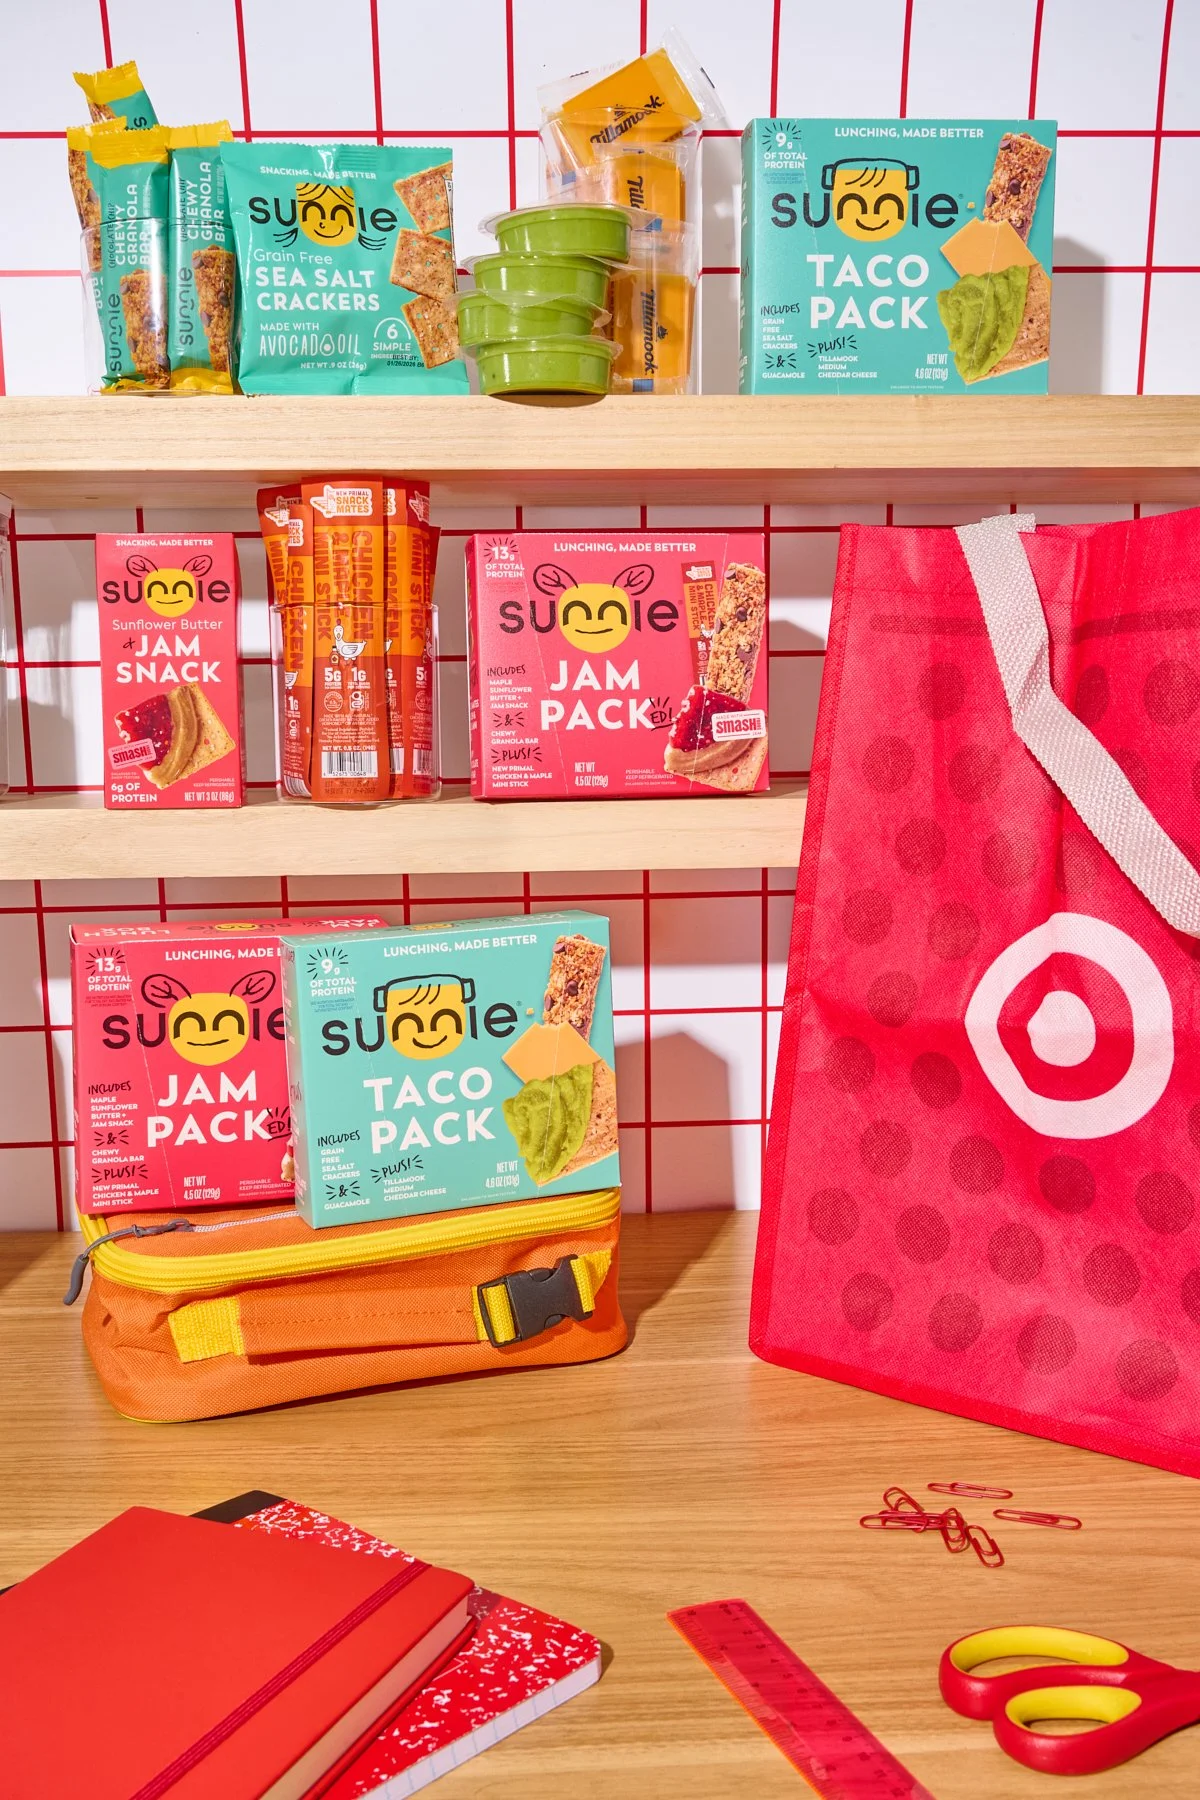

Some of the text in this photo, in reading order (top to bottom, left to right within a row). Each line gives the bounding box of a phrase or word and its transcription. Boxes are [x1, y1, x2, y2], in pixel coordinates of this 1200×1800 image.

[835, 128, 983, 138] LUNCHING, MADE BETTER
[764, 152, 808, 160] OF TOTAL
[342, 171, 376, 180] BETTER
[200, 162, 212, 240] GRANOLA
[186, 181, 198, 240] CHEWY
[249, 197, 398, 232] sunnie
[771, 193, 958, 228] sunnie
[127, 184, 138, 265] GRANOLA
[215, 210, 225, 241] BAR
[115, 204, 125, 265] CHEWY
[139, 232, 151, 265] BAR
[254, 249, 332, 264] Grain Free
[256, 267, 374, 288] SEA SALT
[807, 254, 929, 288] TACO
[178, 267, 194, 345] sunnie
[257, 292, 380, 311] CRACKERS
[761, 303, 800, 316] INCLUDES
[810, 297, 928, 329] PACK
[109, 293, 122, 371] sunnie
[260, 323, 290, 331] MADE
[387, 324, 398, 338] 6
[641, 289, 659, 375] Tillamook
[338, 334, 361, 355] OIL
[373, 343, 411, 351] SIMPLE
[819, 337, 846, 352] PLUS!
[492, 546, 514, 560] 13g
[554, 543, 696, 553] LUNCHING, MADE BETTER
[103, 580, 230, 604] sunnie
[352, 531, 372, 640] CHICKEN
[499, 600, 679, 633] sunnie
[112, 619, 223, 631] Sunflower Butter
[135, 635, 200, 657] JAM
[116, 662, 221, 683] SNACK
[487, 665, 525, 676] INCLUDES
[550, 660, 640, 691] JAM
[503, 749, 530, 760] PLUS!
[112, 794, 157, 802] PROTEIN
[383, 934, 537, 958] LUNCHING, MADE BETTER
[166, 949, 235, 961] LUNCHING,
[238, 948, 274, 958] MADE
[95, 957, 120, 973] 13g
[102, 974, 132, 983] TOTAL
[310, 977, 356, 989] OF TOTAL
[89, 983, 130, 991] PROTEIN
[311, 986, 354, 997] PROTEIN
[321, 1002, 518, 1056] sunnie
[89, 1081, 131, 1094] INCLUDES
[158, 1070, 257, 1107] JAM
[363, 1066, 493, 1112] TACO
[91, 1103, 138, 1111] SUNFLOWER
[91, 1119, 133, 1128] JAM SNACK
[370, 1107, 496, 1154] PACK
[317, 1130, 360, 1147] INCLUDES
[92, 1149, 119, 1157] CHEWY
[321, 1147, 344, 1155] GRAIN
[92, 1156, 128, 1164] GRANOLA
[321, 1156, 340, 1164] FREE
[338, 1162, 355, 1170] SALT
[104, 1167, 135, 1180] PLUS!
[322, 1170, 360, 1180] CRACKERS
[383, 1159, 410, 1177] PLUS!
[111, 1182, 139, 1190] PRIMAL
[383, 1174, 425, 1185] TILLAMOOK
[93, 1188, 159, 1199] CHICKEN MAPLE
[384, 1185, 414, 1194] MEDIUM
[384, 1187, 447, 1202] CHEDDAR CHEESE
[111, 1198, 133, 1206] STICK
[324, 1198, 370, 1210] GUACAMOLE
